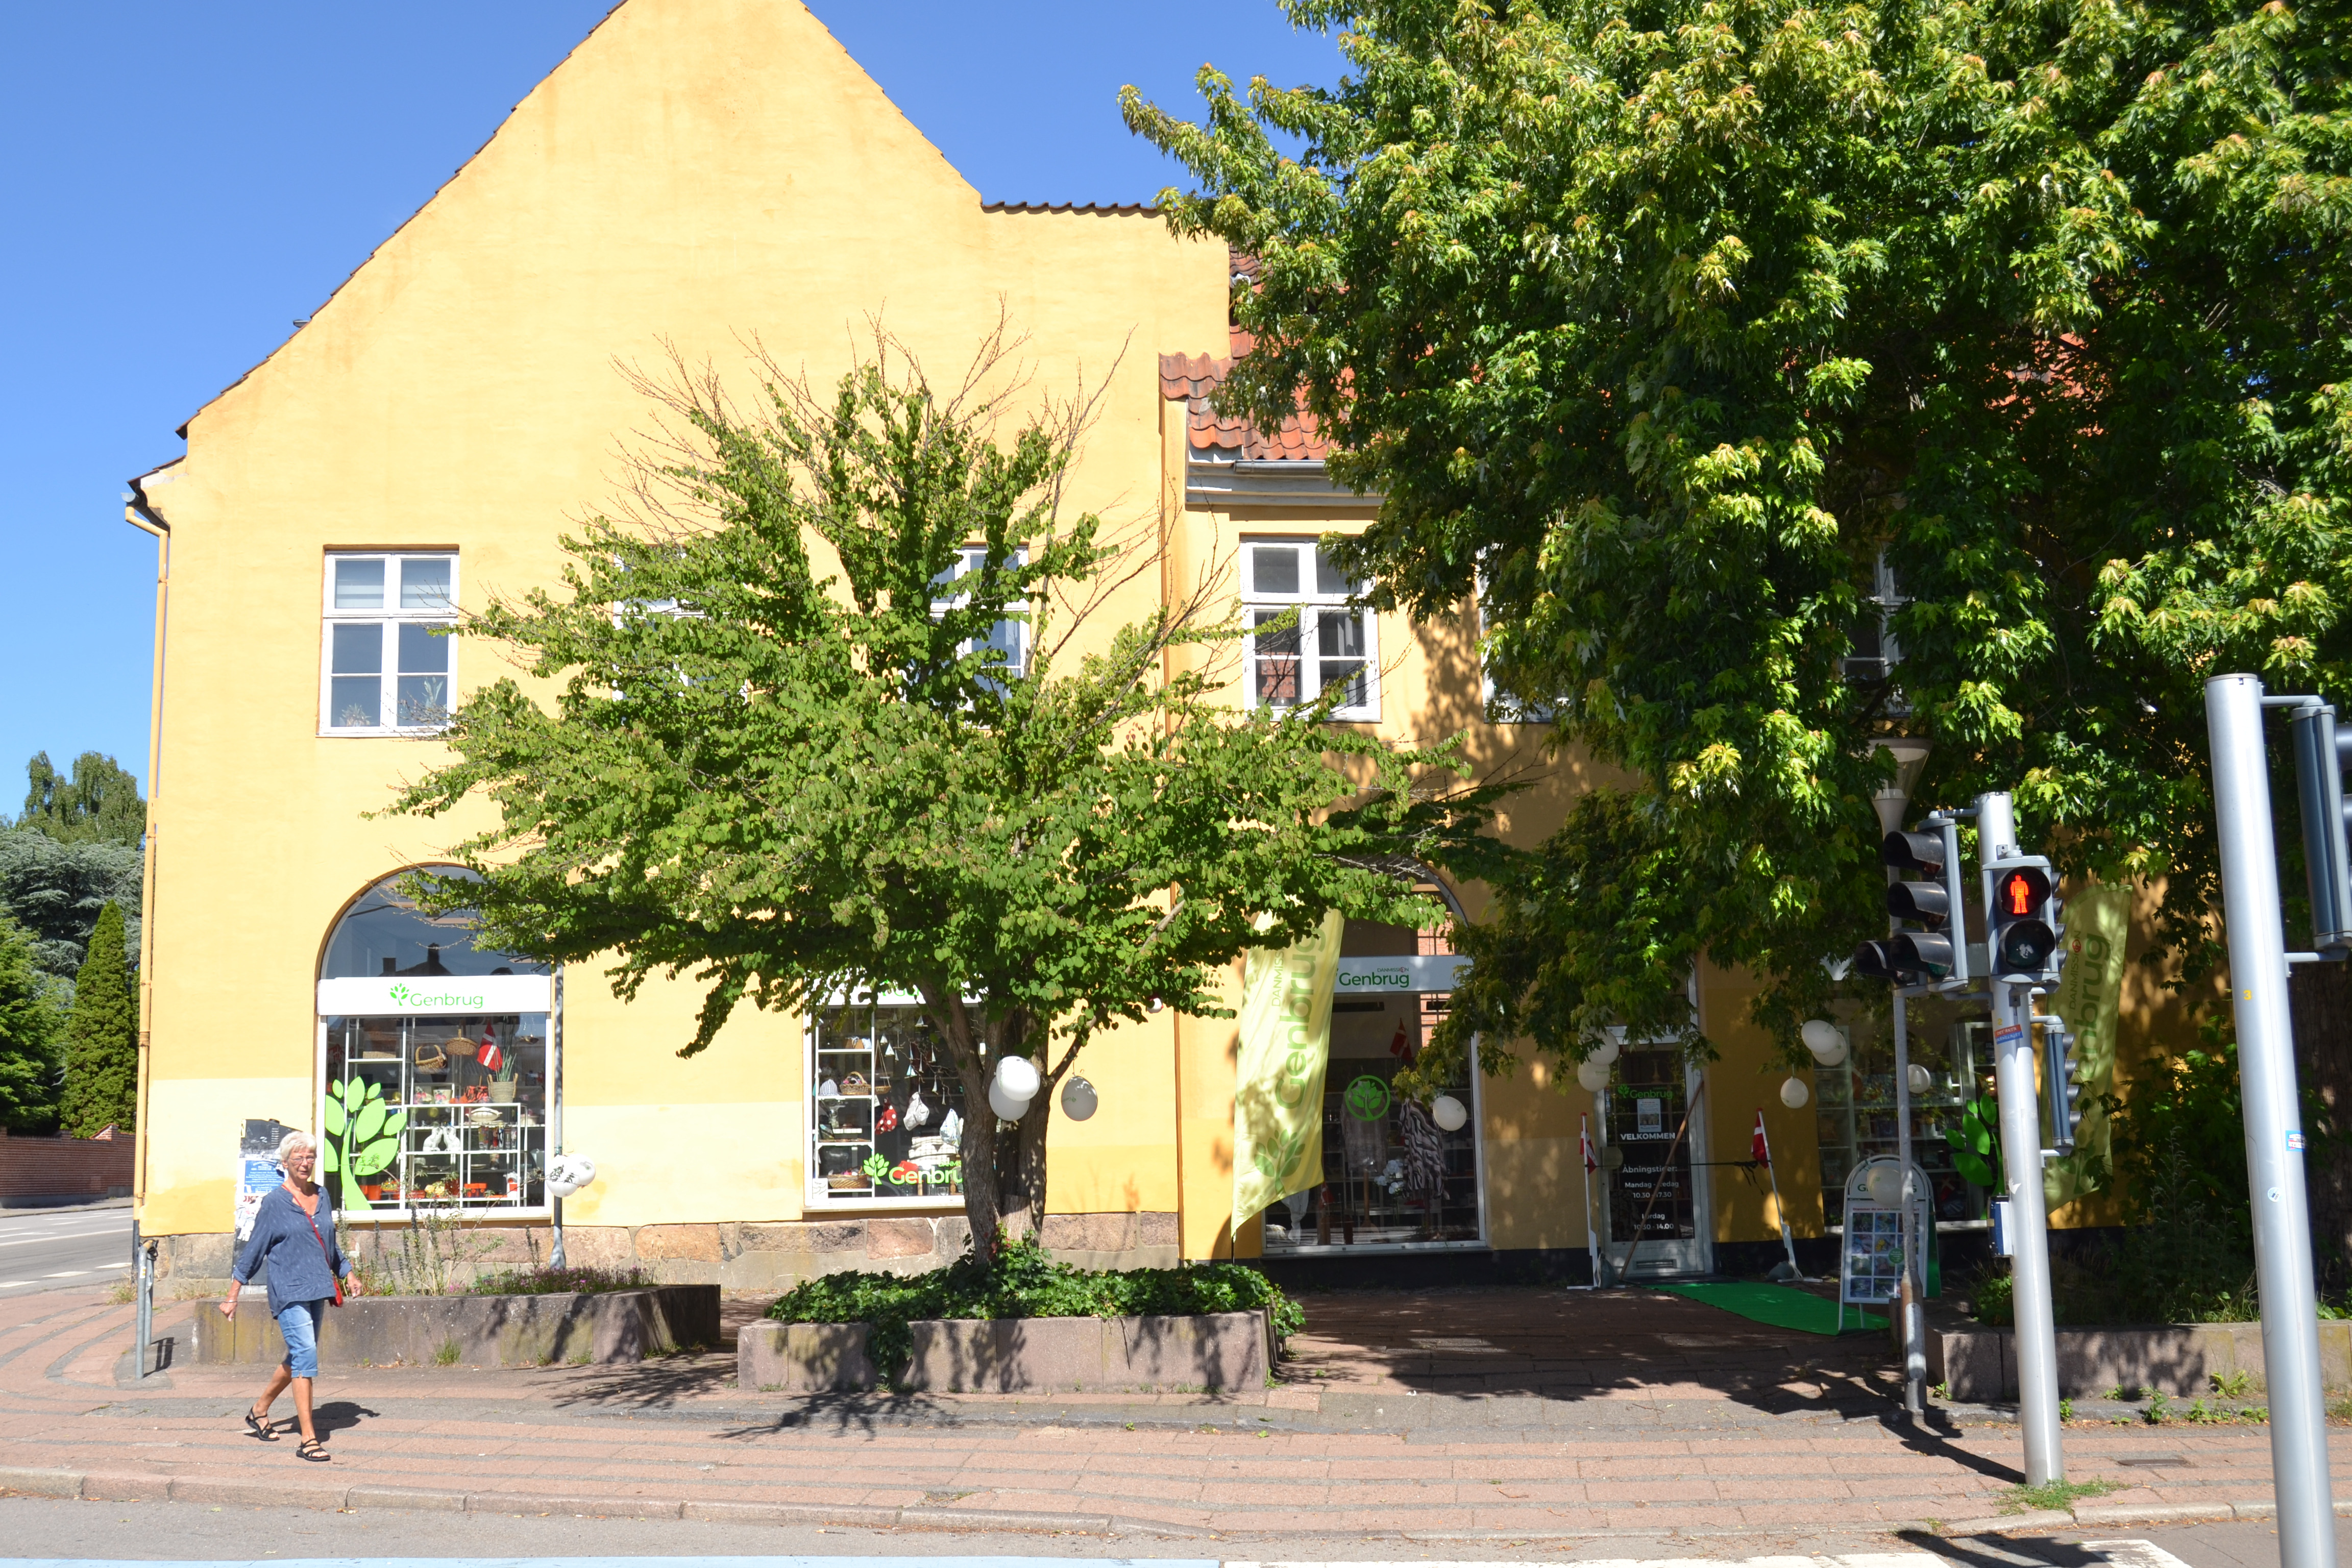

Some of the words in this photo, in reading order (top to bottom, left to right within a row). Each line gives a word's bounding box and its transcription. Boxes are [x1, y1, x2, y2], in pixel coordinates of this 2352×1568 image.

[1271, 950, 1285, 1007] DANMISS
[1338, 972, 1409, 988] Genbrug
[410, 993, 483, 1009] Genbrug
[2243, 989, 2252, 1000] 3
[1629, 1089, 1673, 1100] Genbrug
[1620, 1132, 1676, 1140] VELKOMMEN
[889, 1166, 963, 1185] Genbru
